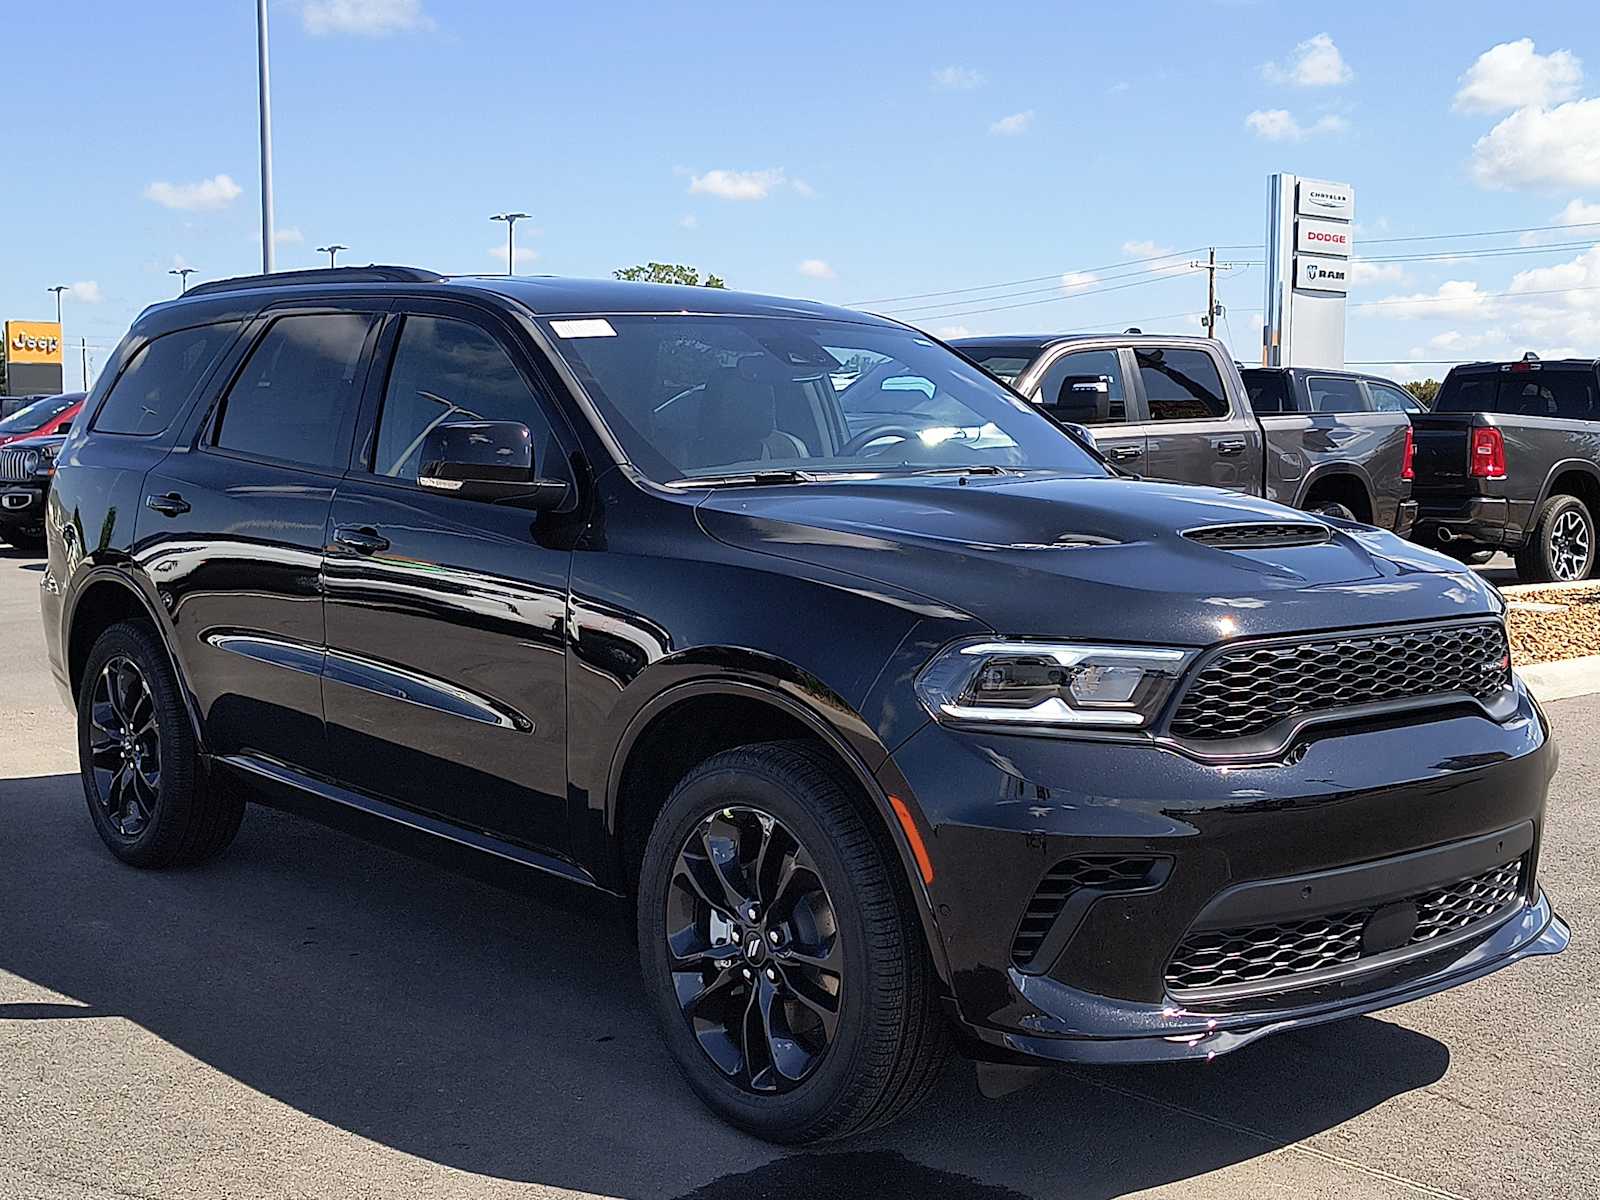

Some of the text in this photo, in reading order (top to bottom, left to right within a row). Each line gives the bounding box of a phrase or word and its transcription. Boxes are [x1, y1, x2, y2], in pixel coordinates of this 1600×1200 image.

[1310, 191, 1346, 201] CHRYSLER
[1307, 231, 1346, 244] DODGE
[1319, 269, 1345, 280] RAM
[12, 331, 58, 354] Jeep
